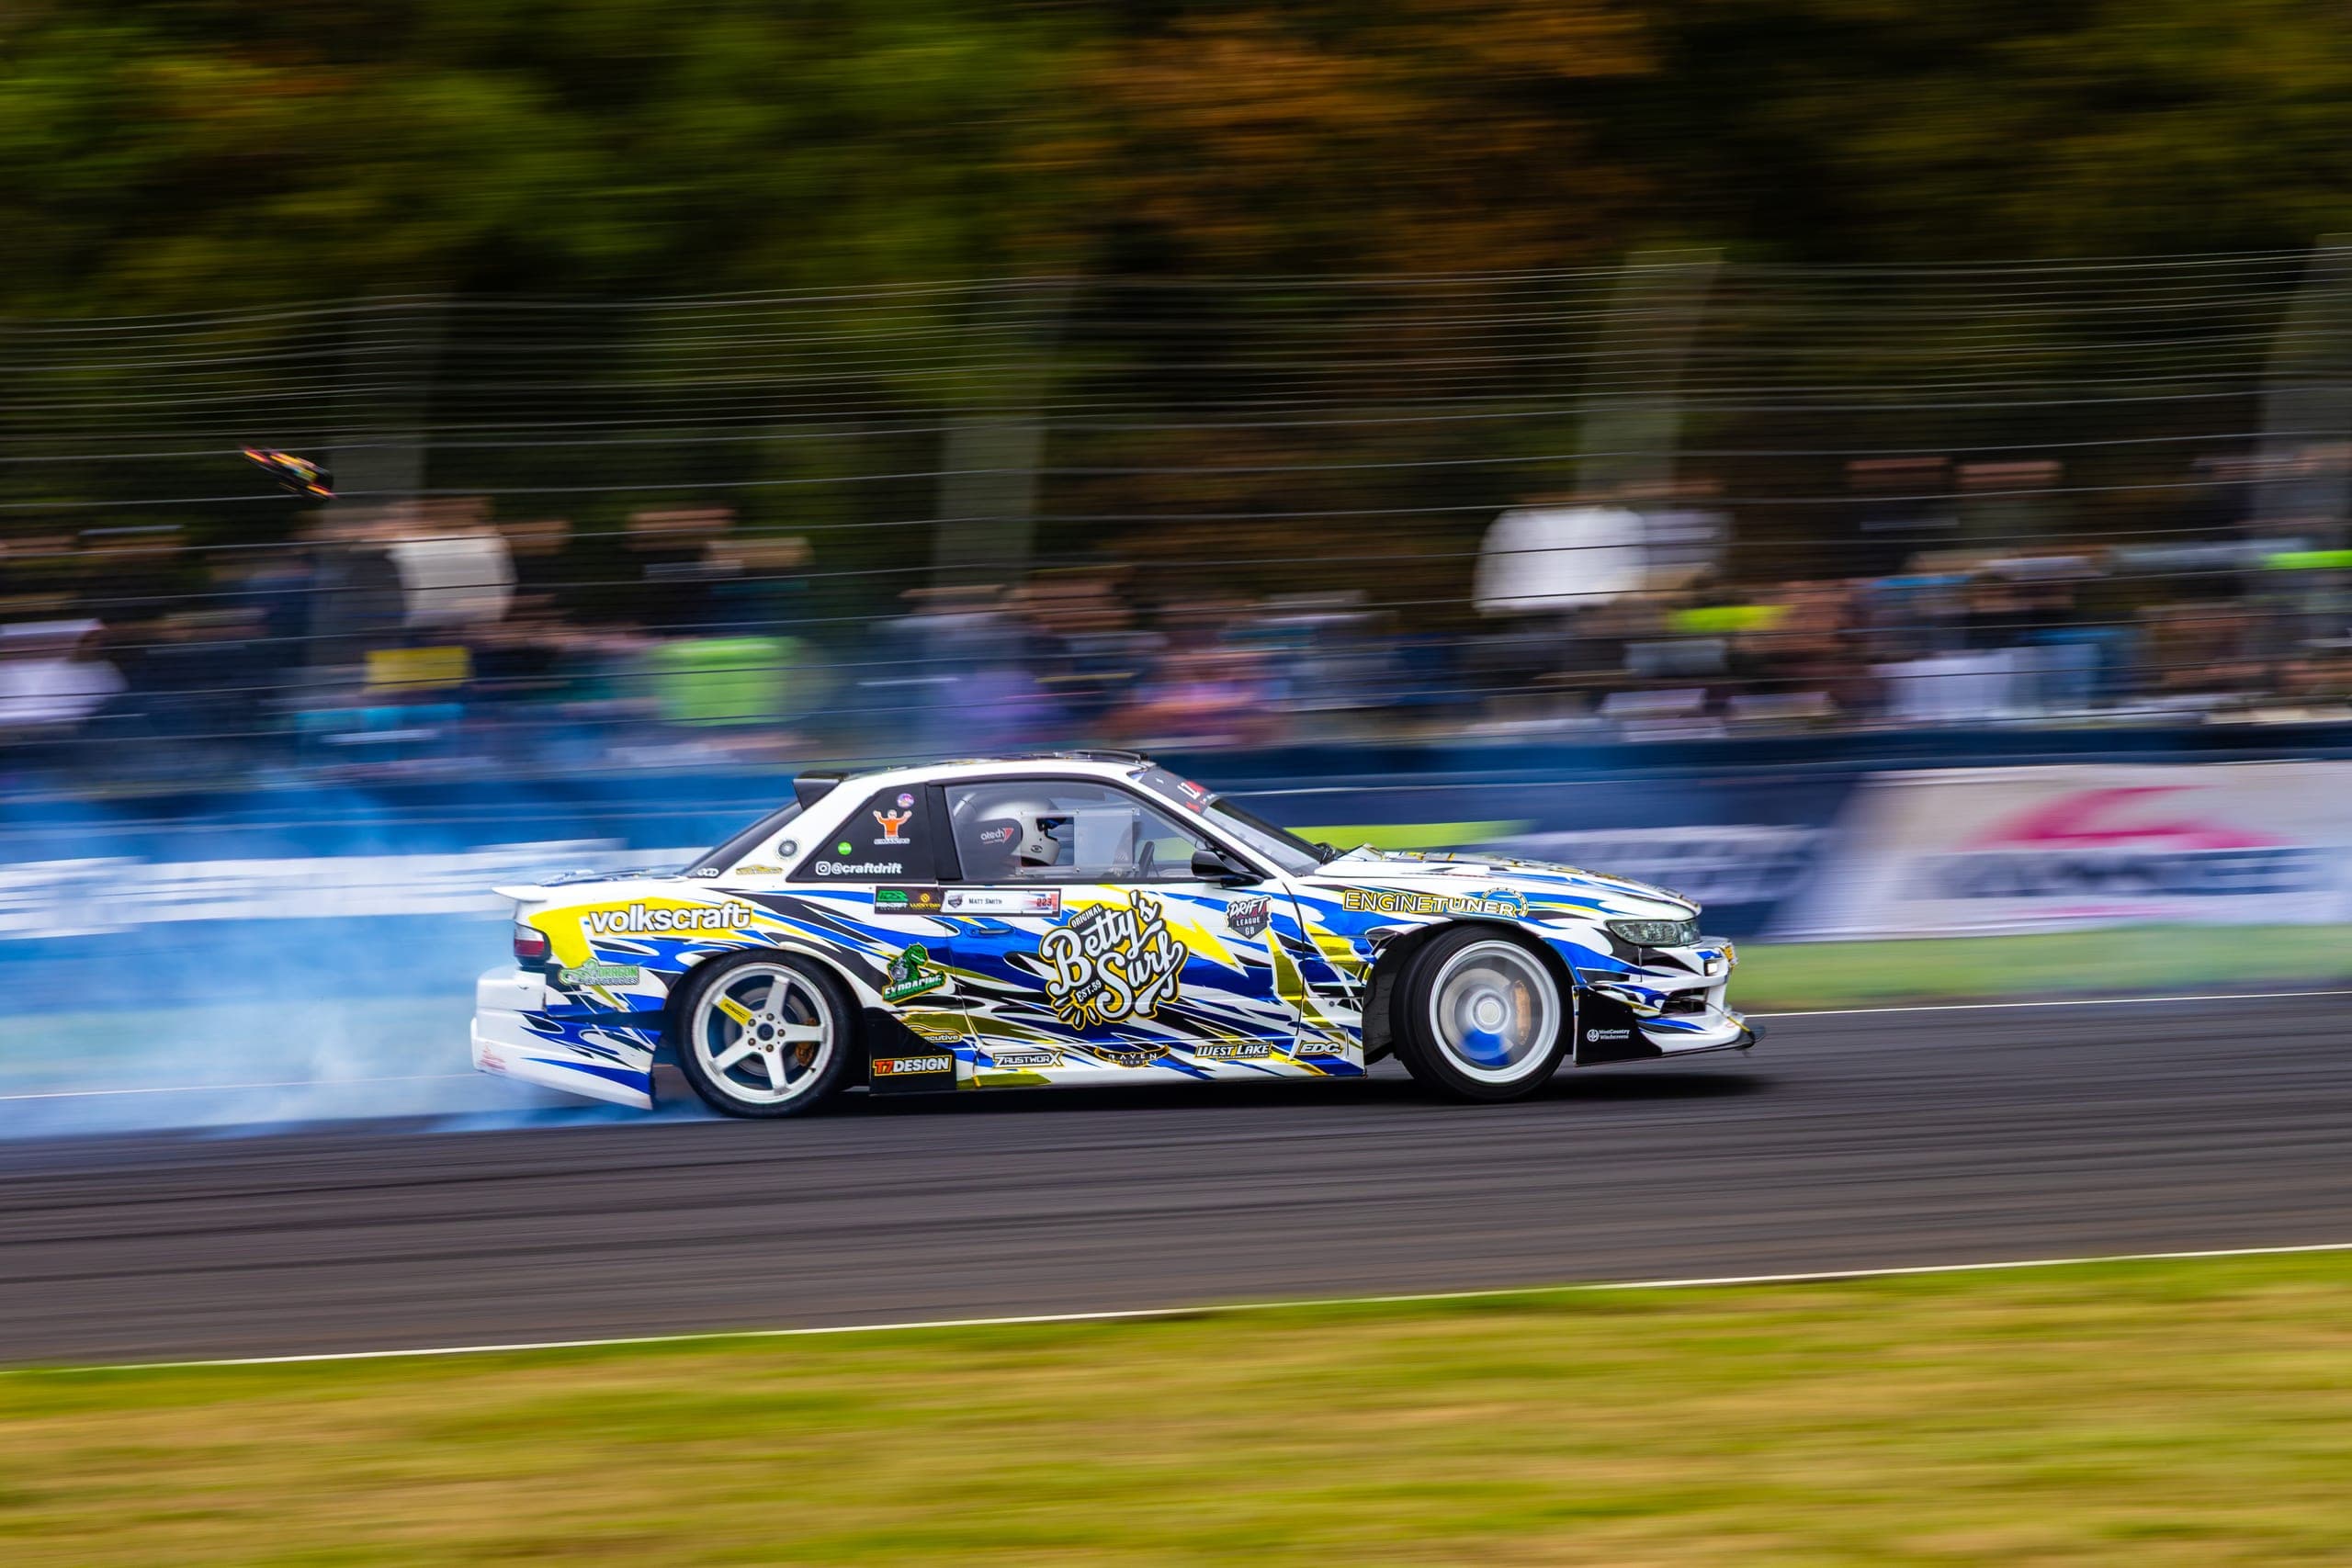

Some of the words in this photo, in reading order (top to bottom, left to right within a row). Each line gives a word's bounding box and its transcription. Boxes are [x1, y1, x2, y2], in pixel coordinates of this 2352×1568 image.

[831, 863, 902, 874] @craftdrift
[1036, 897, 1052, 907] 223
[1229, 897, 1271, 919] DRIFT
[1345, 891, 1517, 918] ENGINETUNER
[590, 902, 750, 933] volkscraft
[1071, 904, 1102, 929] ORIGINAL
[1236, 916, 1261, 927] LEAGUE
[1245, 926, 1255, 935] GB
[1042, 890, 1163, 996] Betty's
[1096, 930, 1184, 1019] Surf
[1075, 979, 1102, 1002] EST.59
[1196, 1045, 1234, 1057] WEST
[1236, 1043, 1270, 1056] LAKE
